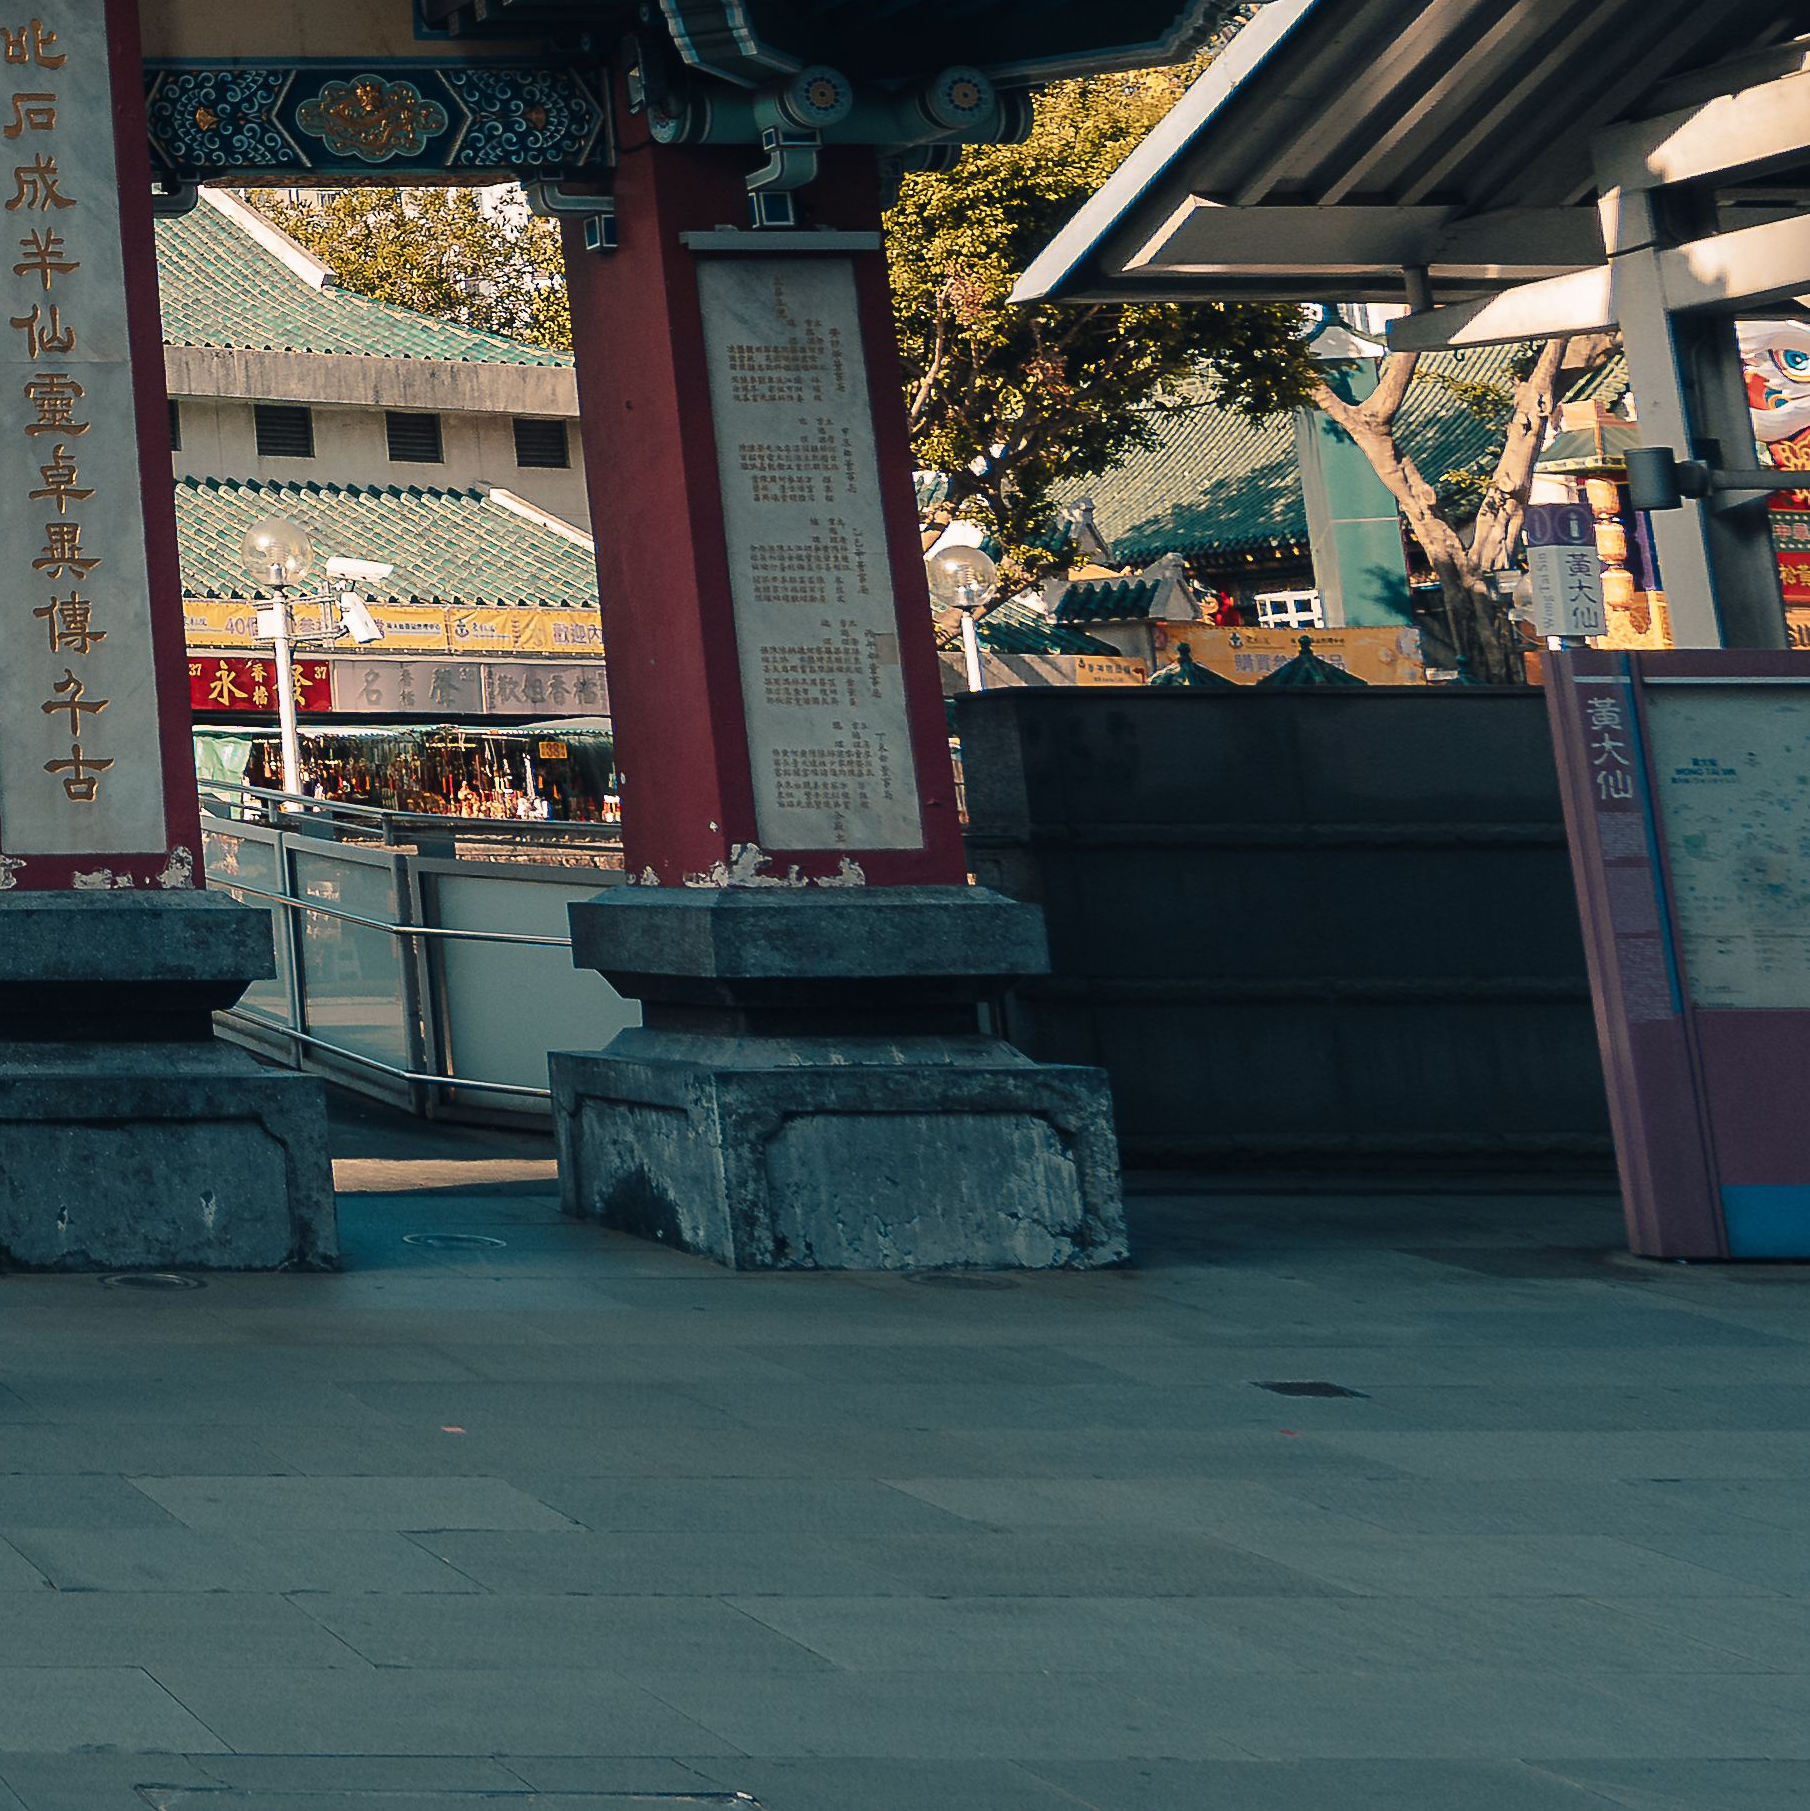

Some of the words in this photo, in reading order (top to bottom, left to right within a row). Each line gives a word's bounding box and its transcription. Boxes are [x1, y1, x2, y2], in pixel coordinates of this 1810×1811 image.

[1564, 552, 1599, 630] 黃大仙
[189, 663, 202, 676] 37
[314, 667, 327, 680] 37
[1586, 696, 1635, 800] 黃大仙
